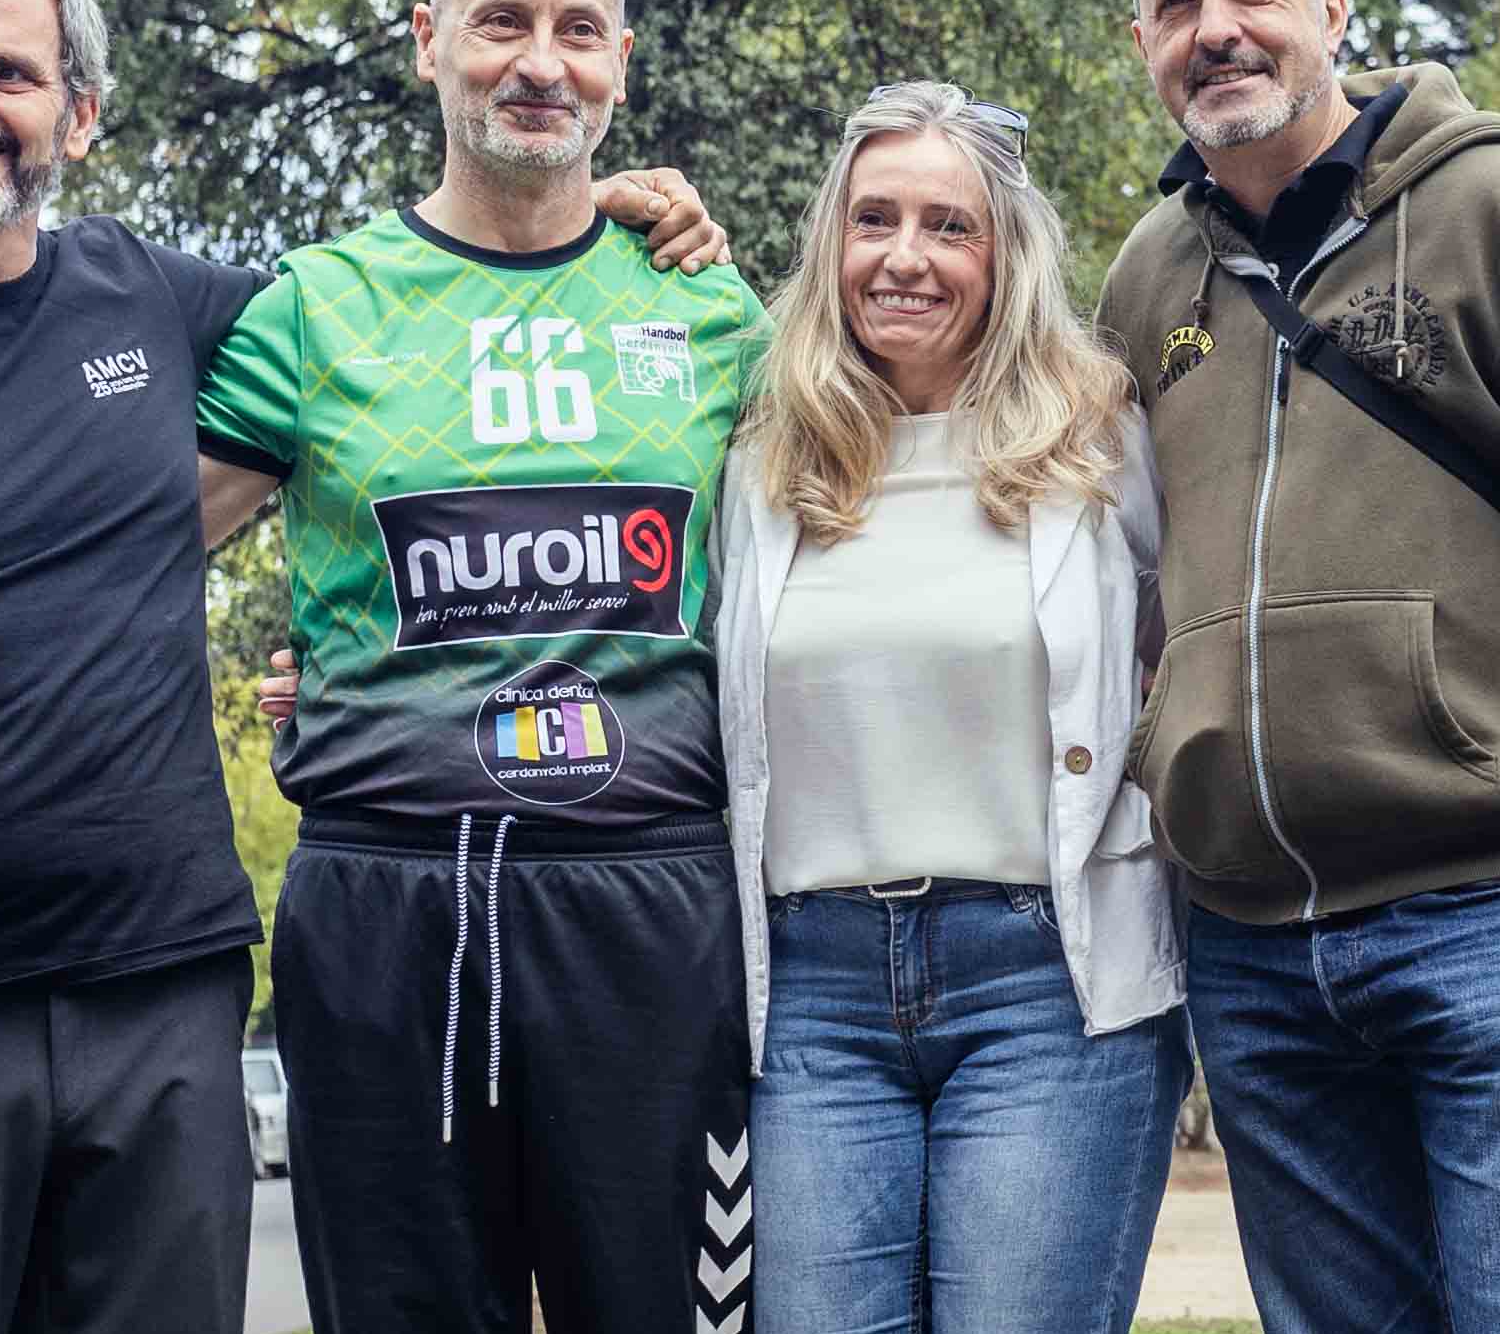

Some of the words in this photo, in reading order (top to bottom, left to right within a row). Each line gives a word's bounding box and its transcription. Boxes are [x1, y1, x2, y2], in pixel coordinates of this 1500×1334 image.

[641, 325, 687, 343] Handbol
[470, 315, 597, 444] 66
[481, 593, 518, 616] amb
[520, 591, 534, 613] el
[537, 589, 584, 612] millor
[585, 592, 631, 610] servei
